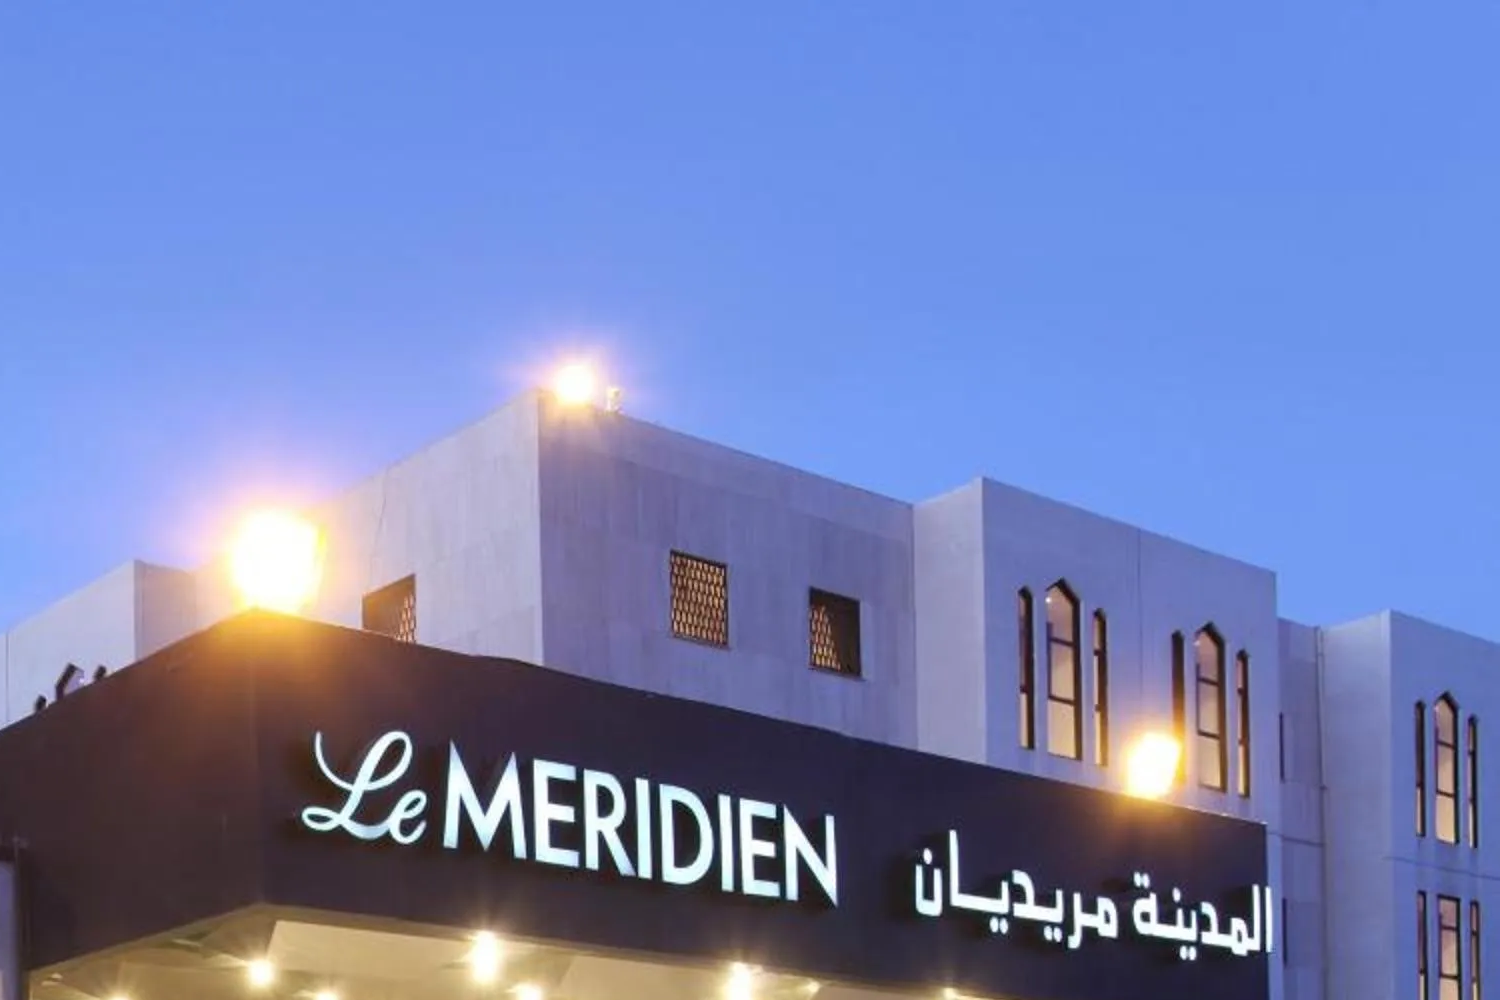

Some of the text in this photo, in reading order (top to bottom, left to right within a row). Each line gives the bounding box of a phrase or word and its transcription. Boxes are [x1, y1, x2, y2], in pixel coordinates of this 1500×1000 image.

[301, 730, 839, 906] Le MERIDIEN
[915, 829, 1274, 961] المدينة مريديان
